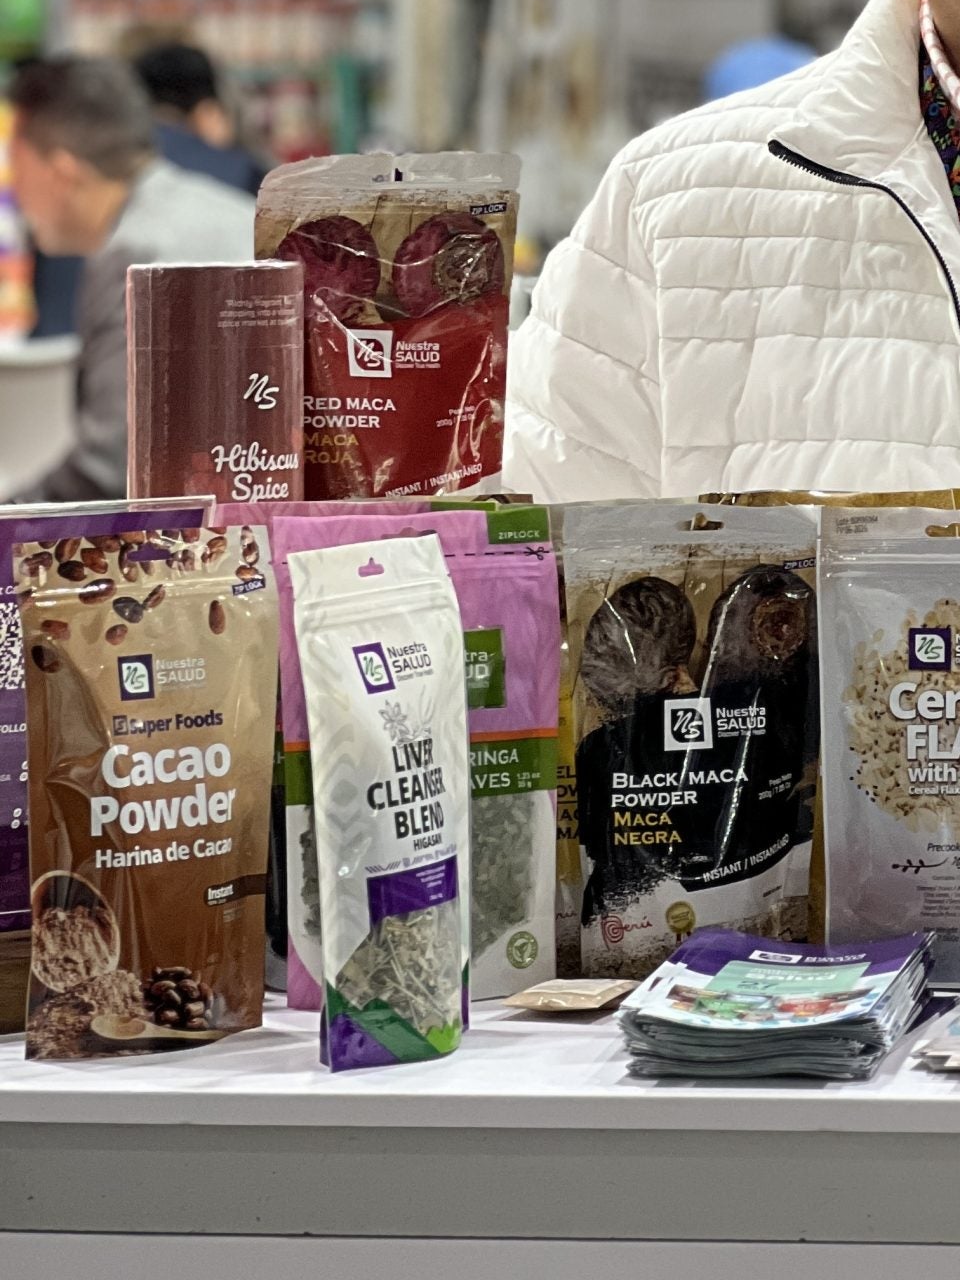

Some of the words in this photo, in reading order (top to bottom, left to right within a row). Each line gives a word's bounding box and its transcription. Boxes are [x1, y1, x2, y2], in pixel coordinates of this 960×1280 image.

[395, 340, 440, 351] Nuestra
[395, 351, 440, 362] SALUD
[304, 396, 341, 411] RED
[346, 398, 396, 411] MACA
[304, 415, 380, 428] POWDER
[211, 442, 299, 473] Hibiscus
[231, 474, 289, 501] Spice
[385, 482, 421, 498] INSTANT
[387, 641, 428, 659] Nuestra
[156, 657, 205, 670] Nuestra
[392, 654, 431, 673] SALUD
[156, 668, 206, 685] SALUD
[716, 706, 766, 718] Nuestra
[130, 718, 172, 738] Super
[175, 709, 223, 730] Foods
[717, 716, 766, 730] SALUD
[393, 738, 433, 772] LIVER
[469, 748, 519, 766] RINGA
[102, 743, 231, 788] Cacao
[908, 763, 957, 783] with
[471, 772, 510, 789] AVES
[612, 772, 680, 789] BLACK
[688, 769, 749, 785] MACA
[367, 767, 446, 810] CLEANSER
[611, 791, 697, 807] POWDER
[90, 783, 235, 837] Powder
[395, 801, 444, 839] BLEND
[613, 812, 672, 827] MACA
[614, 830, 682, 846] NEGRA
[95, 845, 163, 869] Harina
[166, 841, 190, 861] de
[193, 837, 232, 858] Caca
[703, 861, 742, 882] INSTANT
